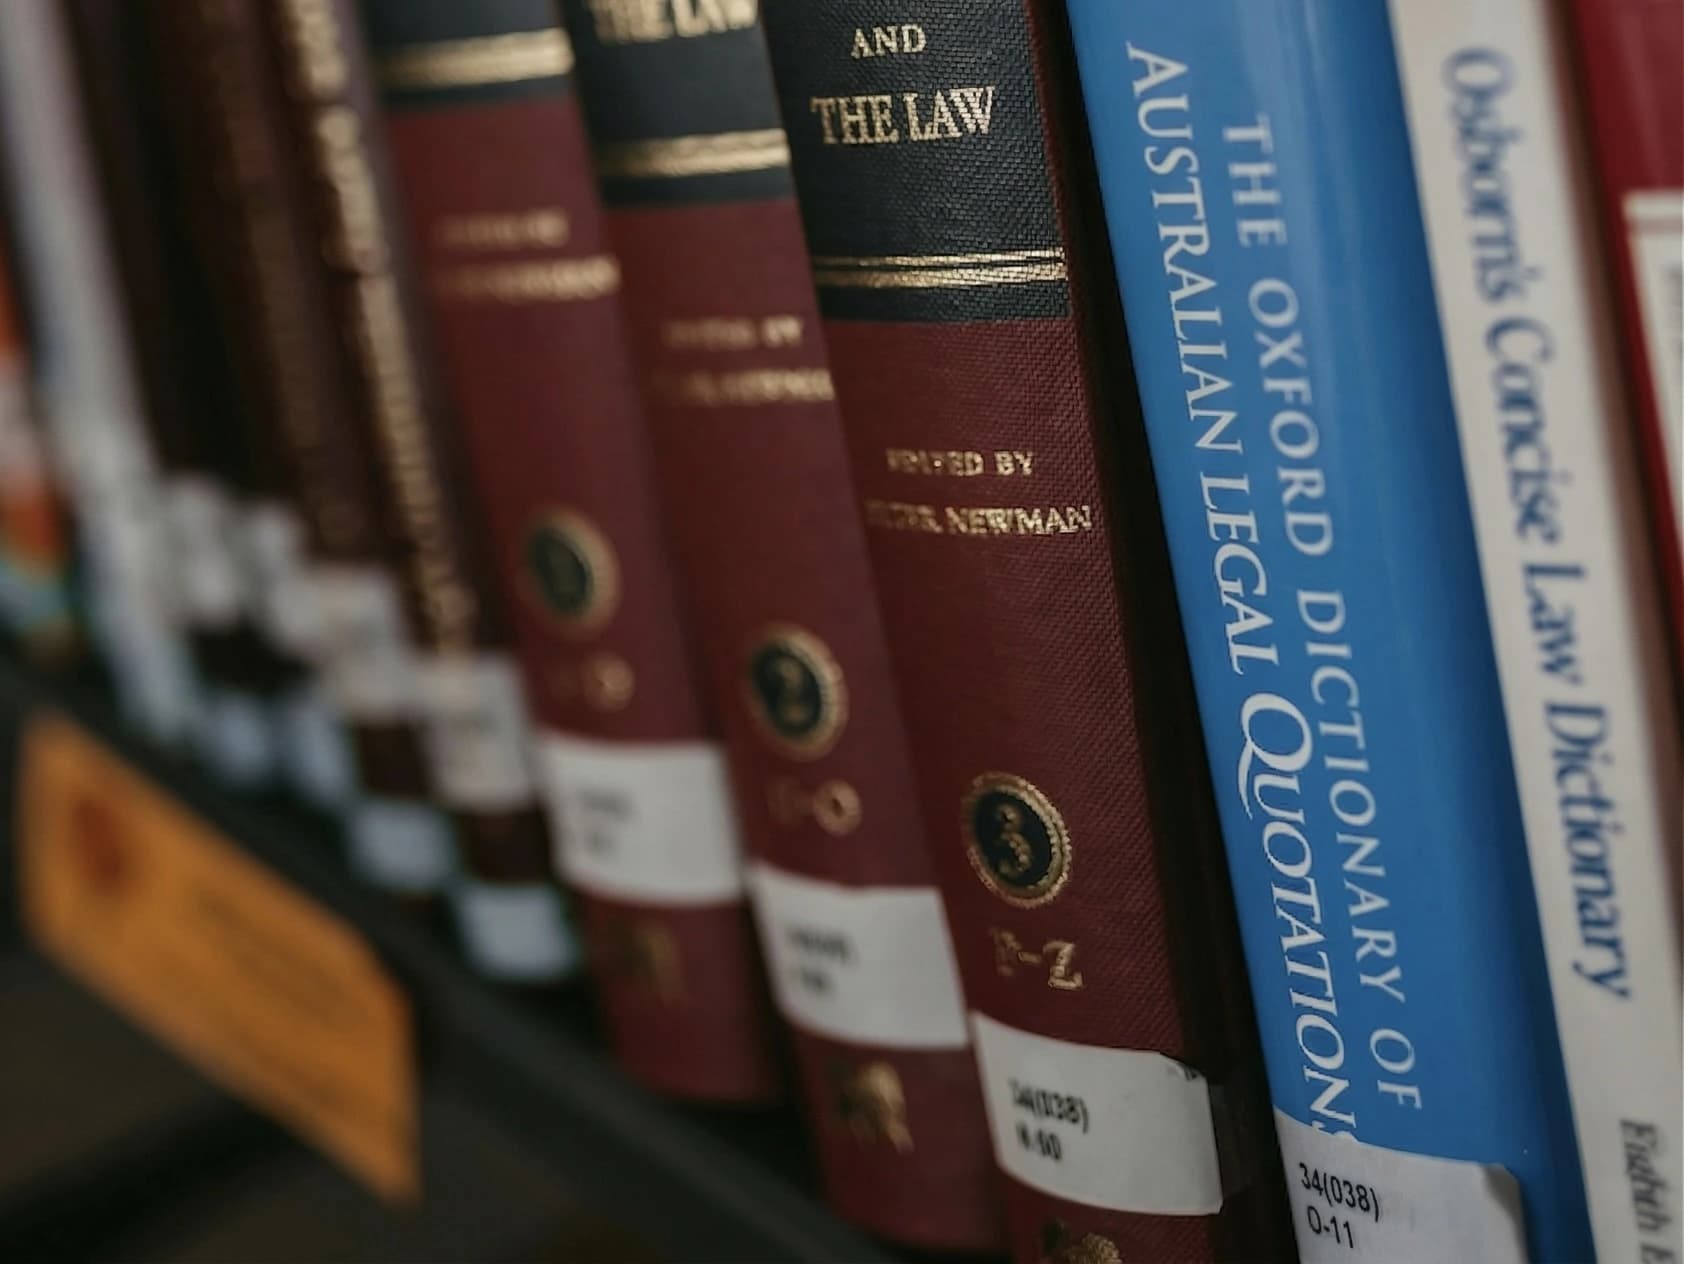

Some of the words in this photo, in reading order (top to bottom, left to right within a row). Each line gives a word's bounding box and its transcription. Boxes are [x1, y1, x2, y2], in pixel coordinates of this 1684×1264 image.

[851, 24, 926, 59] AND
[810, 93, 900, 145] THE
[903, 86, 996, 141] LAW
[1223, 112, 1288, 247] THE
[1125, 41, 1244, 455] AUSTRALIAN
[1201, 471, 1279, 676] LEGAL
[994, 450, 1034, 476] BY
[1248, 277, 1334, 556] OXFORD
[1484, 316, 1572, 547] Concise
[945, 505, 1093, 536] NEWMAN
[1522, 562, 1587, 685] Law
[994, 802, 1033, 877] 3
[1297, 588, 1406, 1004] DICTIONARY
[1542, 701, 1634, 1002] Dictionary
[1369, 1027, 1423, 1111] OF
[1298, 1162, 1379, 1223] 34(038)
